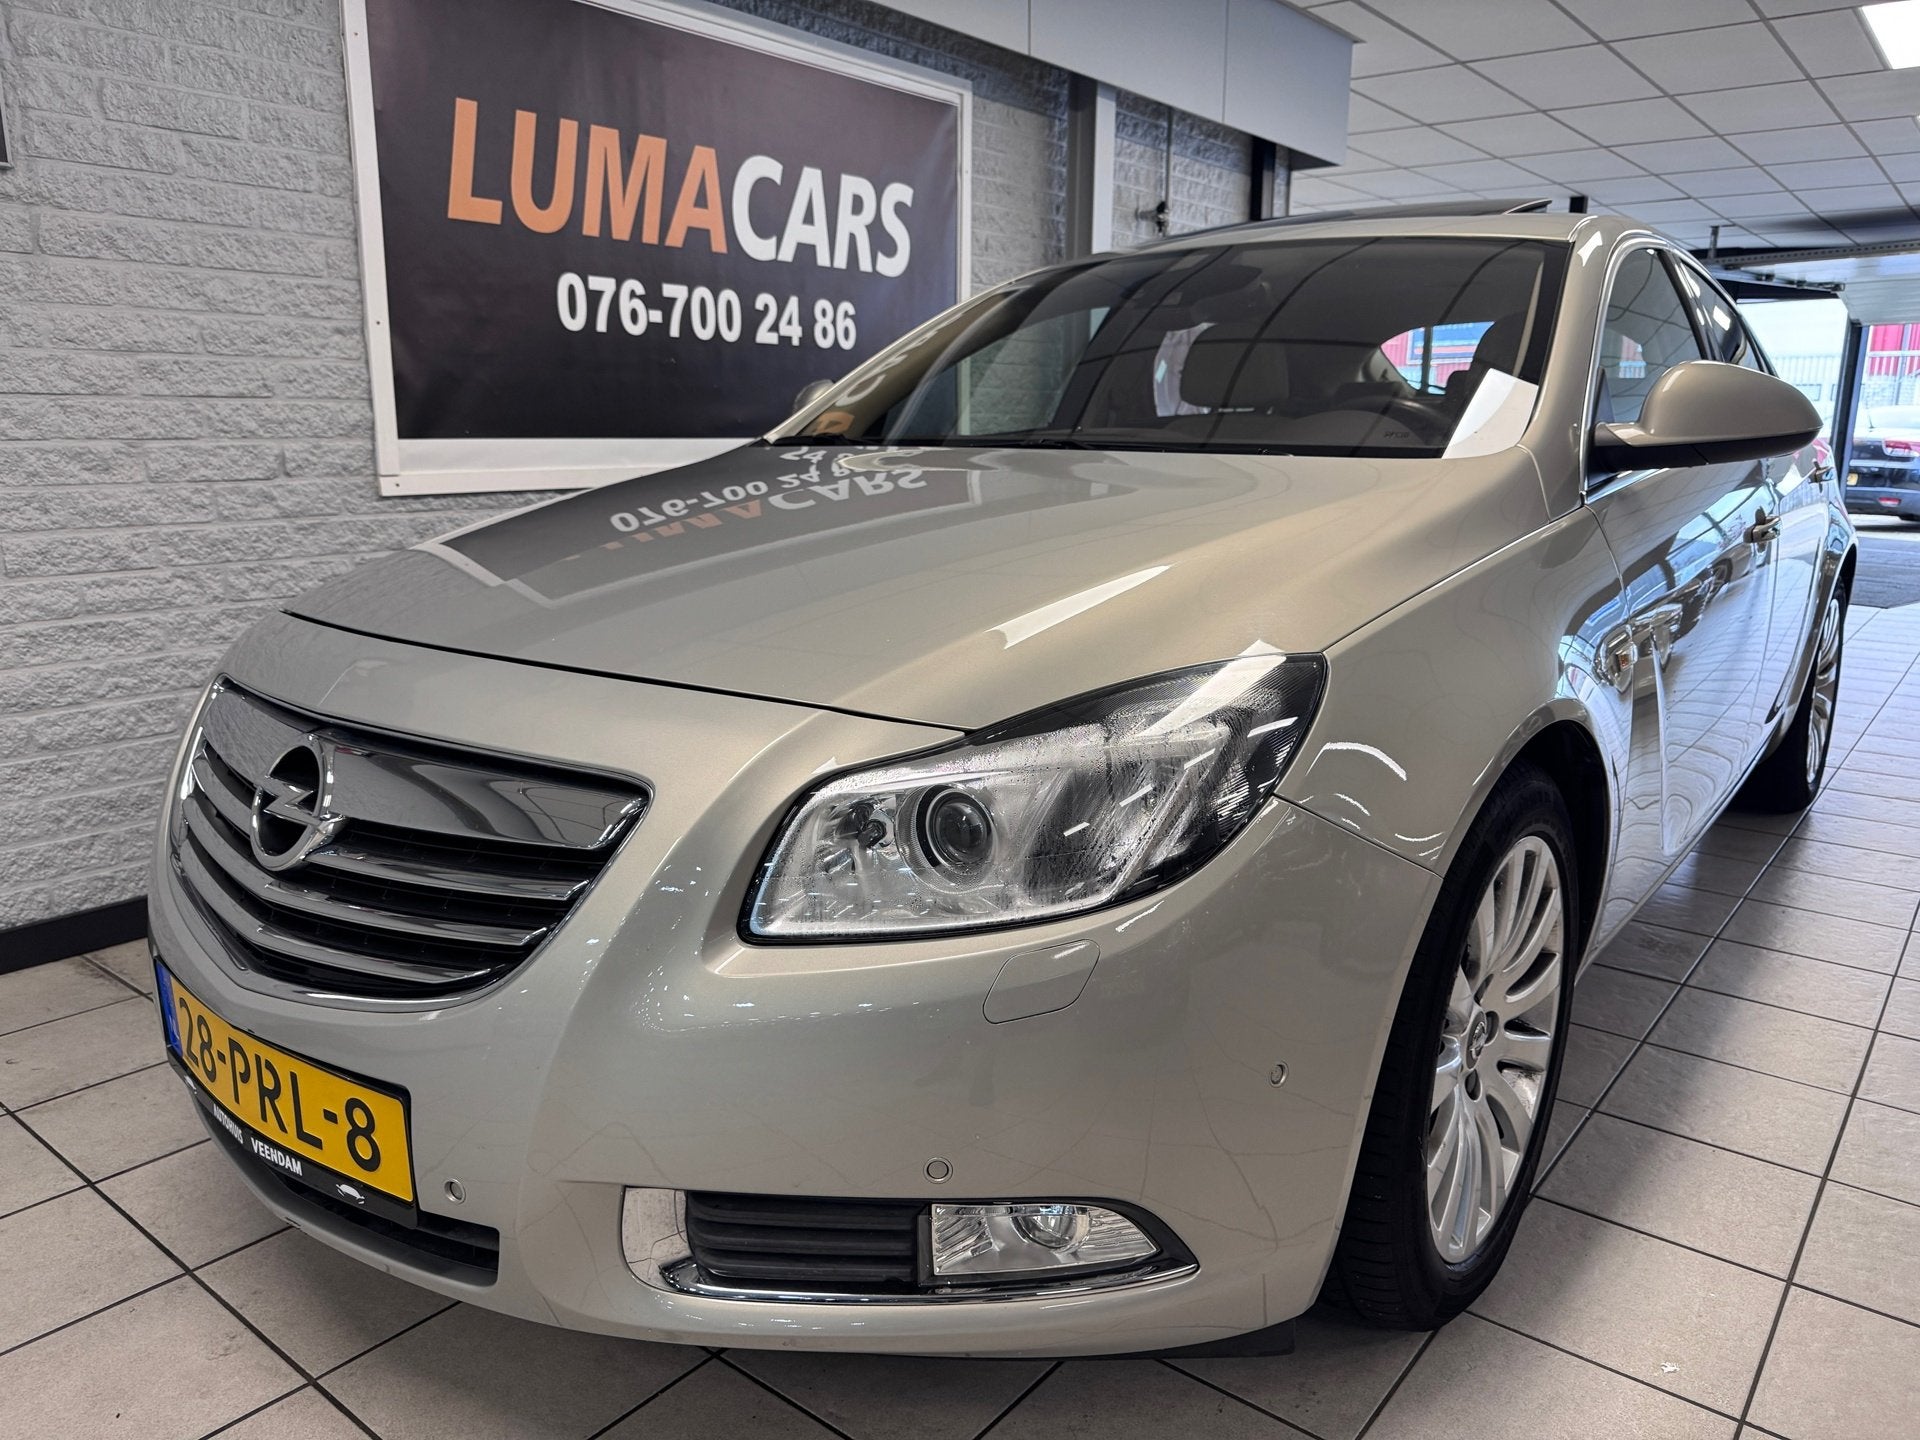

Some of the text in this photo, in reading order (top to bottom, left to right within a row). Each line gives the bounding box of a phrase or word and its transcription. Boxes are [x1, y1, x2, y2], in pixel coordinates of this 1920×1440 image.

[447, 96, 915, 278] LUMACARS
[556, 271, 857, 349] 076-700 24 86
[178, 996, 382, 1173] 28-PRL-8
[250, 1137, 303, 1176] VEENDAM
